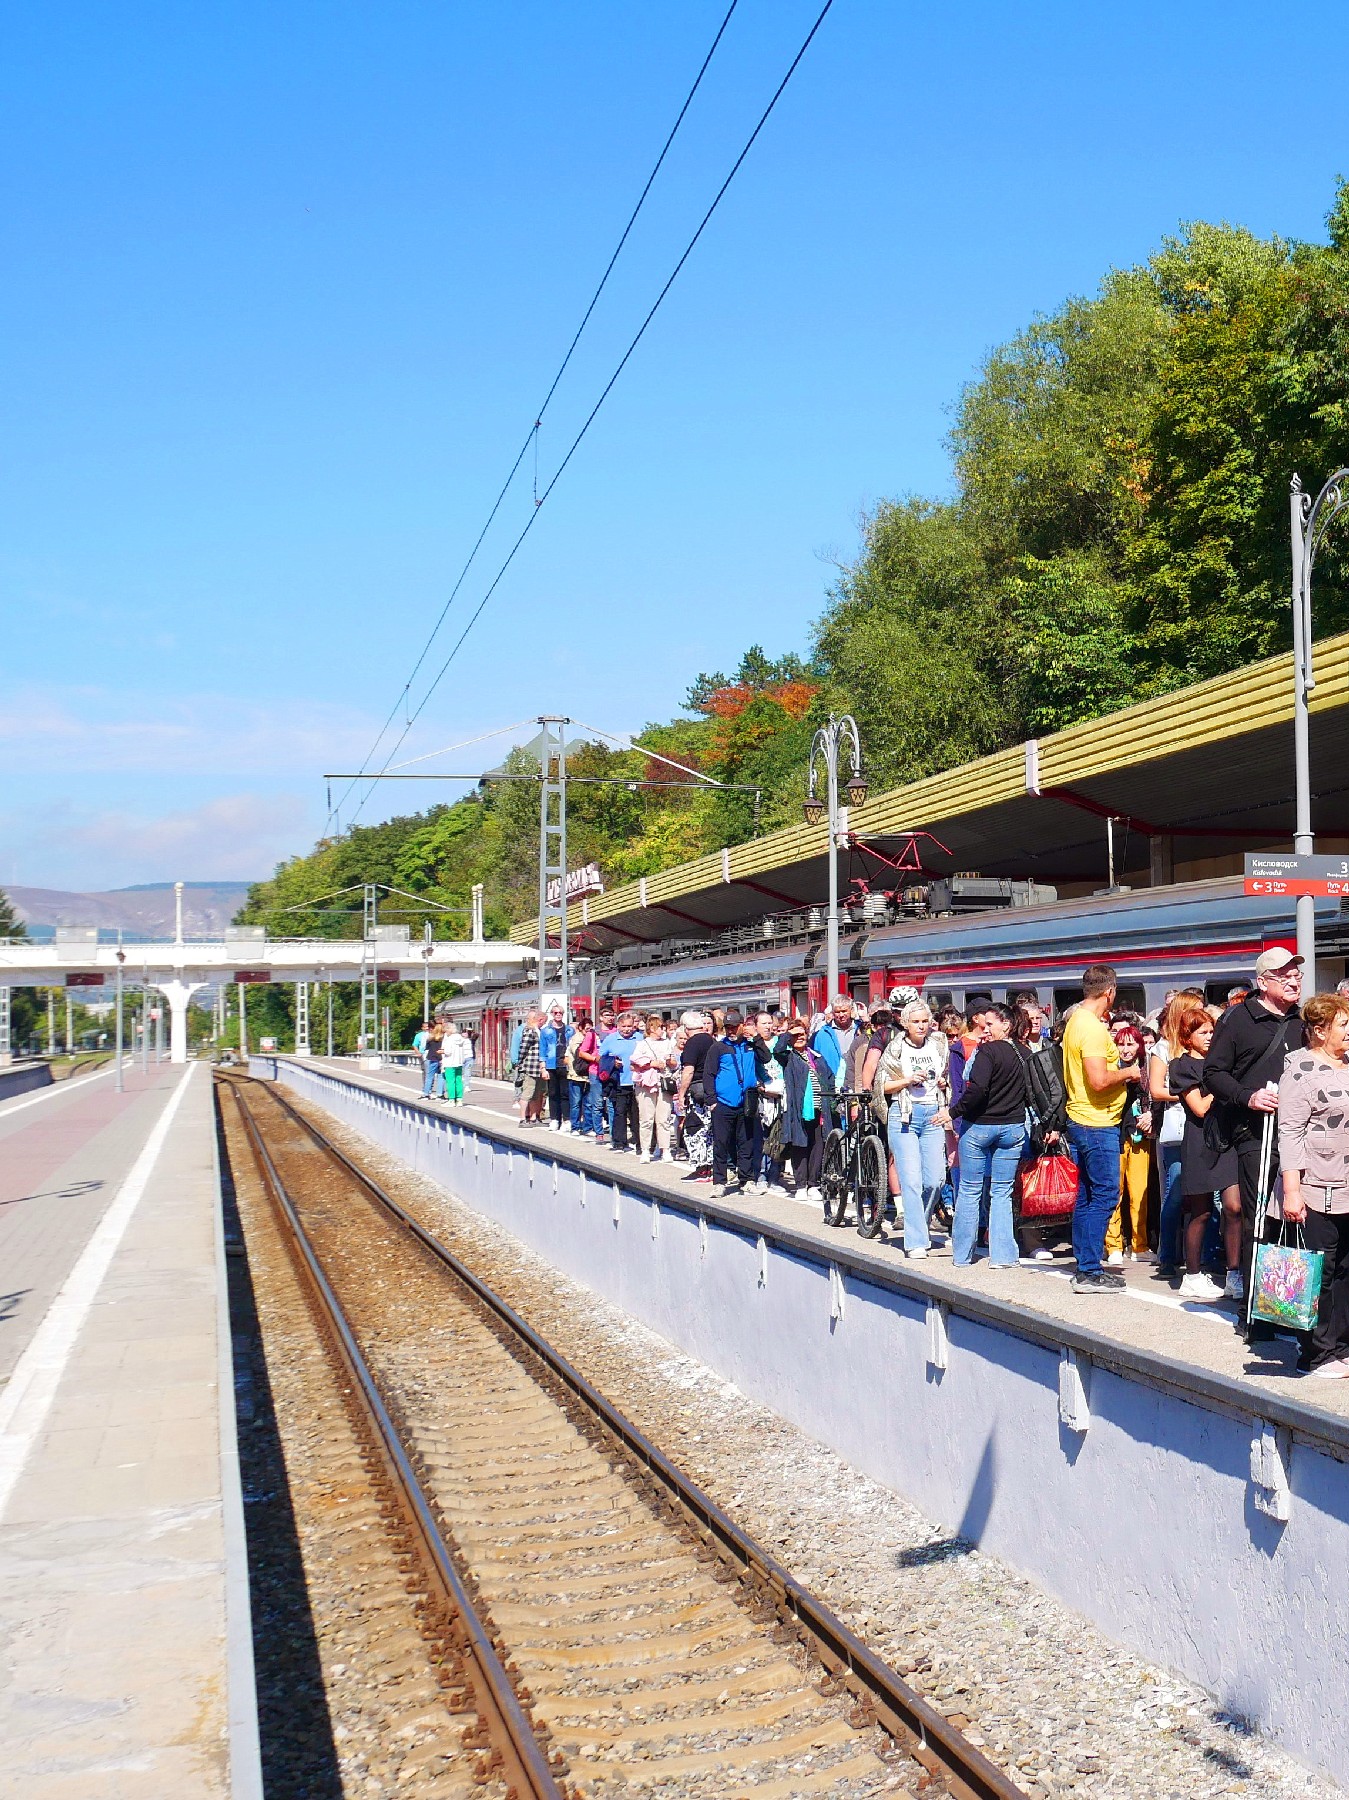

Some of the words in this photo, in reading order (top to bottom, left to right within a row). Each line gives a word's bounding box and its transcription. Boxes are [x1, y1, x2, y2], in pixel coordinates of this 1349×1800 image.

[1252, 859, 1298, 869] Кисловодск
[1340, 861, 1349, 874] 3
[1264, 881, 1273, 893] 3
[1341, 882, 1349, 894] 4
